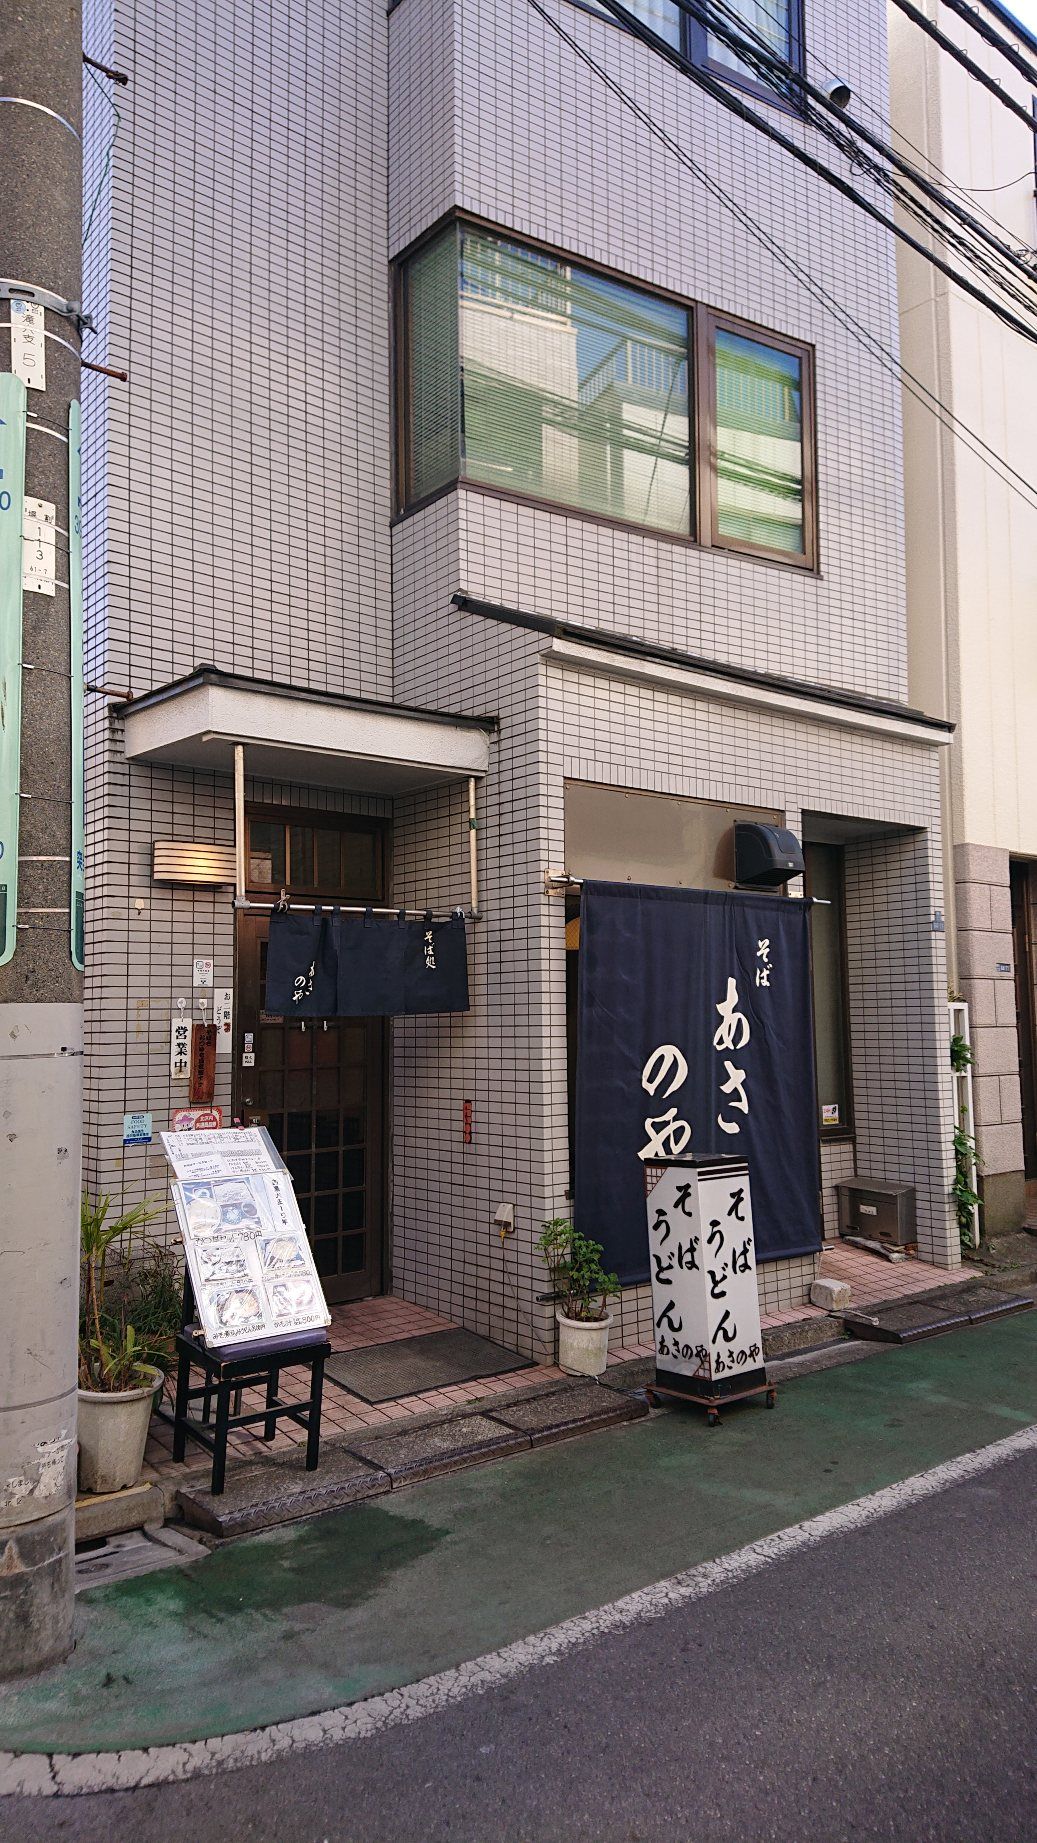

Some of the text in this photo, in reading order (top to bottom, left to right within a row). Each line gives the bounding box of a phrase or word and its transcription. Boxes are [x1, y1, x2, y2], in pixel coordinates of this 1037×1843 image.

[22, 352, 36, 368] 5
[424, 930, 437, 970] そば処
[755, 938, 773, 988] そば
[174, 1025, 189, 1073] 営業中
[713, 977, 750, 1134] あさ
[637, 1044, 692, 1161] のや
[672, 1182, 700, 1272] そば
[727, 1187, 752, 1275] そば
[652, 1208, 683, 1333] うどん
[706, 1219, 737, 1345] うどん
[658, 1334, 709, 1366] あさのや
[714, 1343, 760, 1374] あさのや
